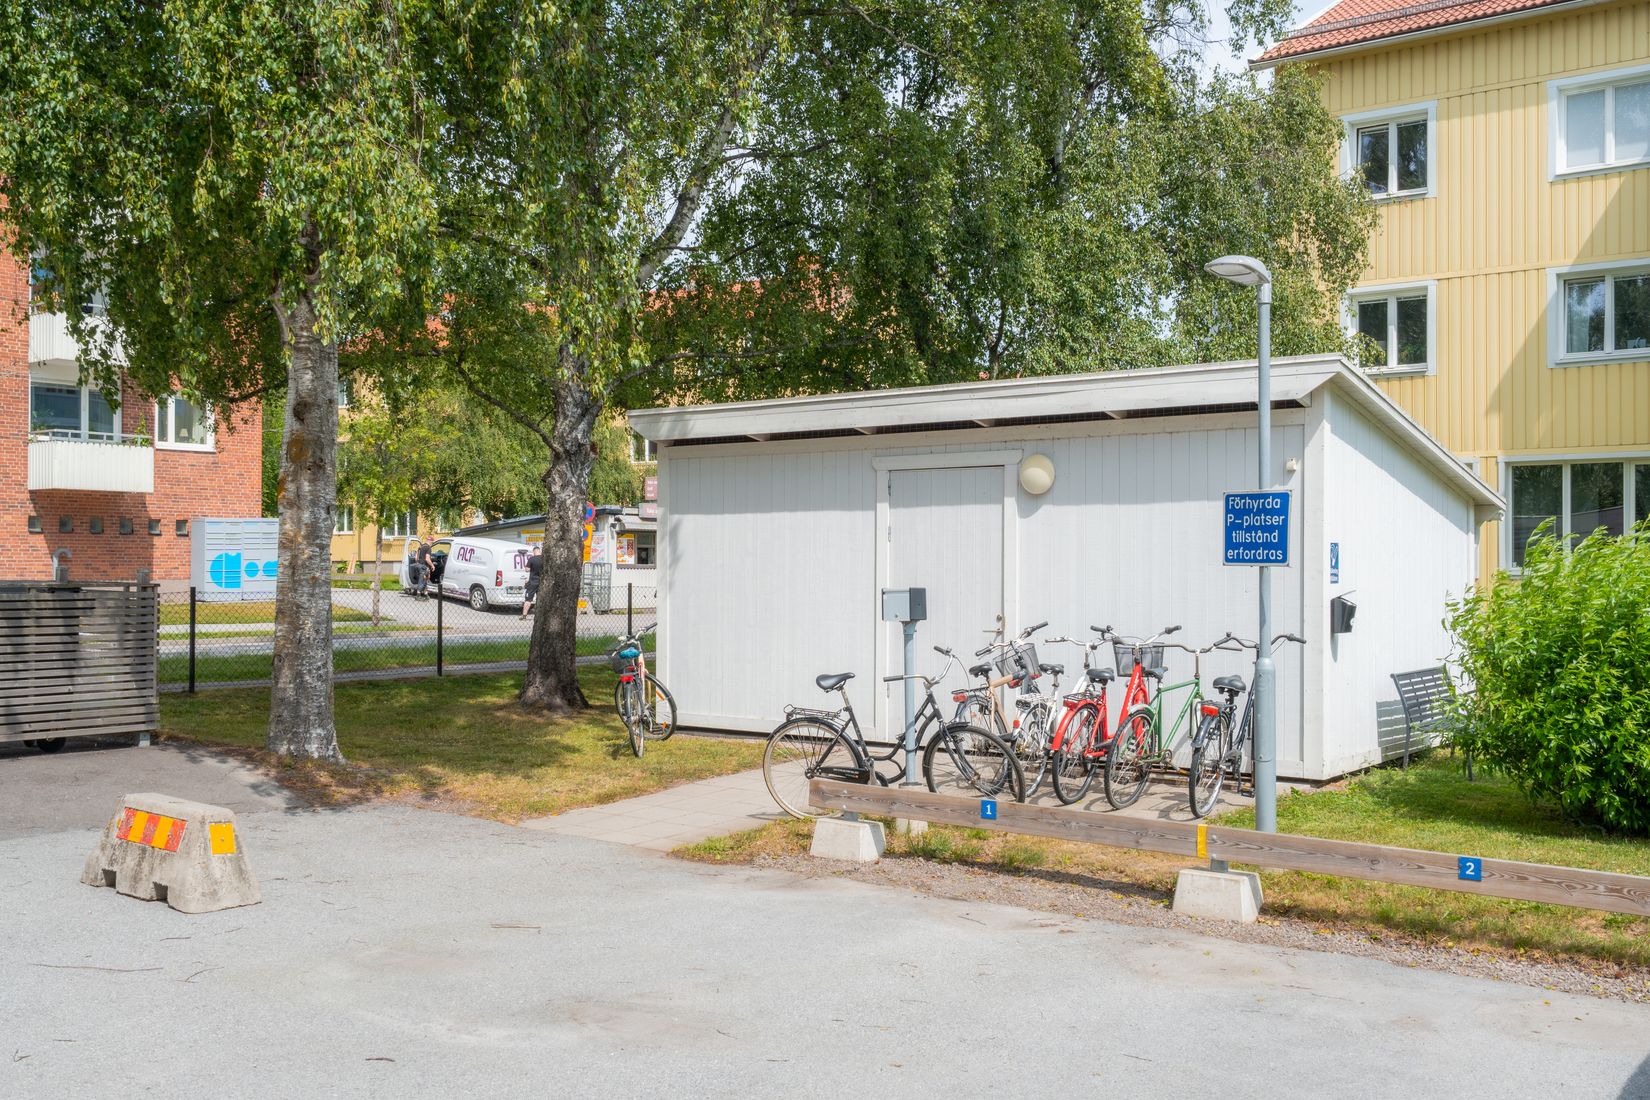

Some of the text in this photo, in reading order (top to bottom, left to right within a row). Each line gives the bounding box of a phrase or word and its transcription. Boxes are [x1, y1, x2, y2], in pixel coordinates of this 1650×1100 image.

[1229, 496, 1281, 512] Förhyrda
[1227, 513, 1285, 528] P-platser
[1232, 529, 1278, 543] tillstånd
[457, 546, 475, 562] ALT
[1227, 547, 1283, 560] erfordras
[986, 804, 992, 815] 1
[1465, 862, 1475, 875] 2
